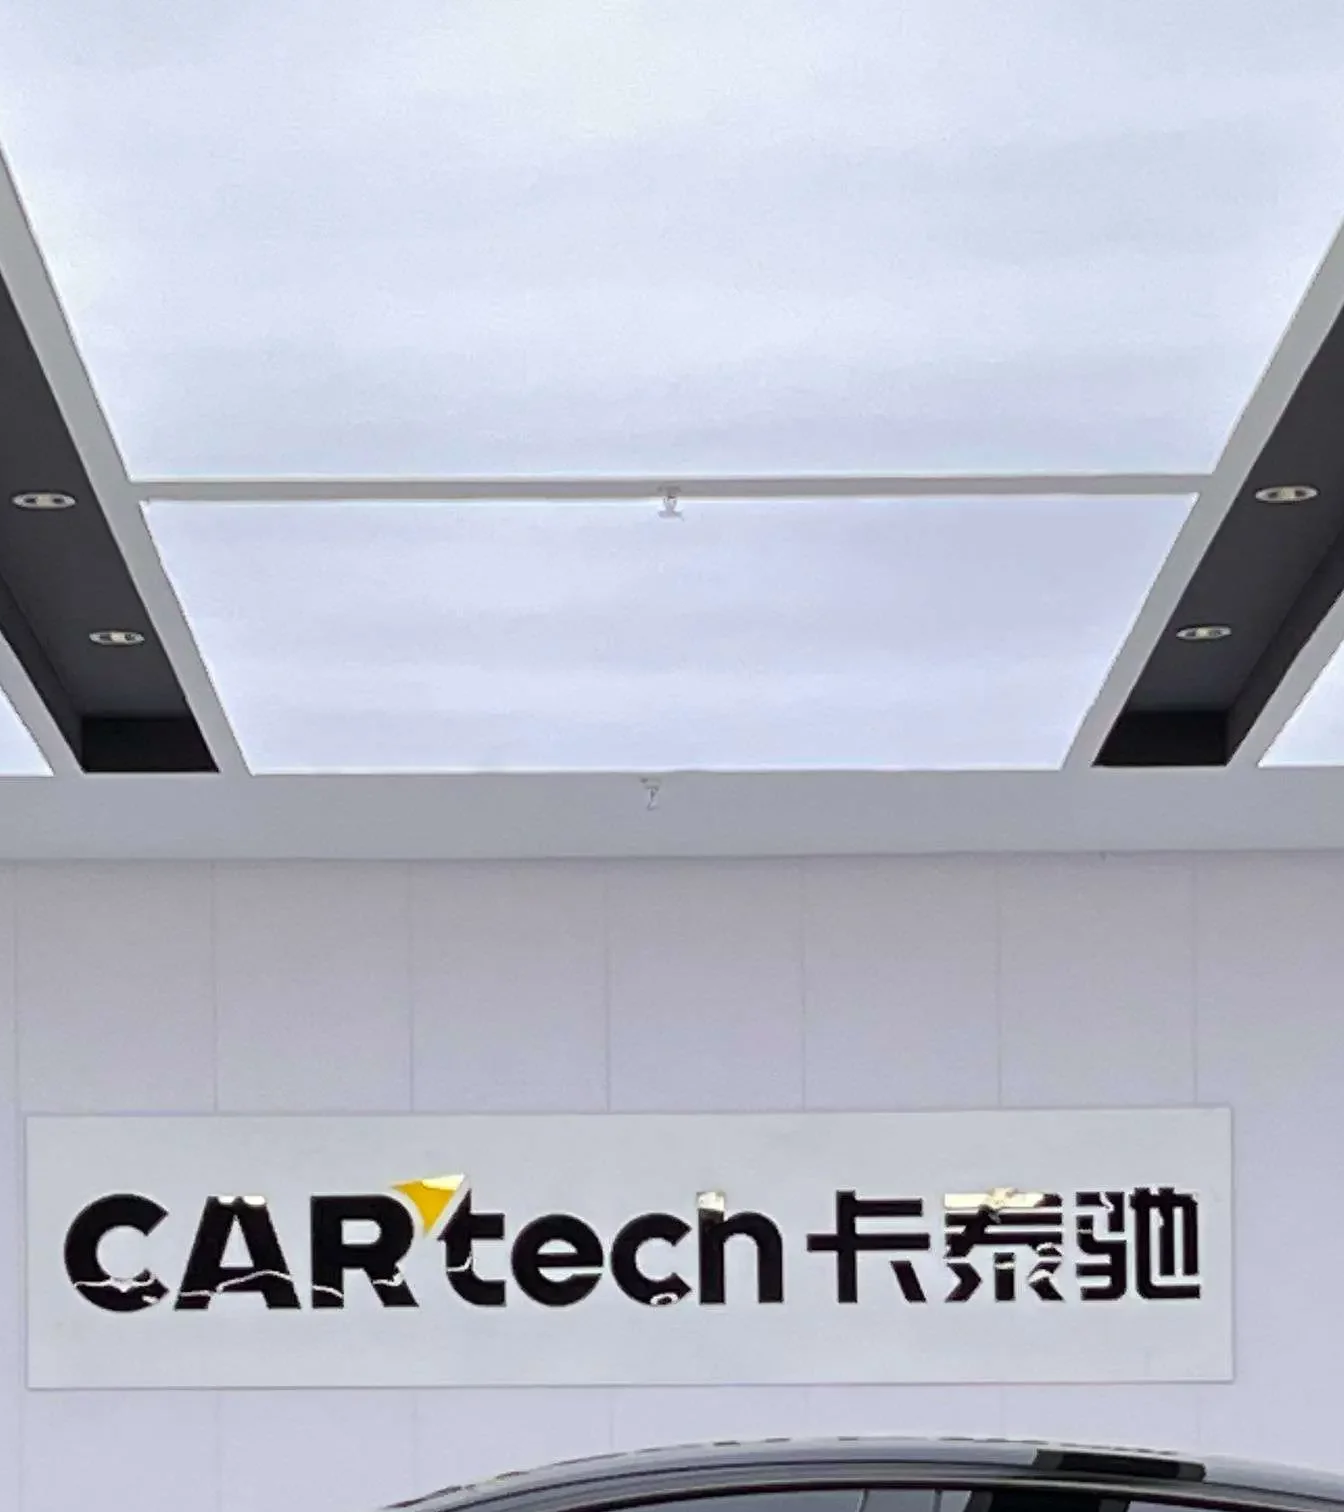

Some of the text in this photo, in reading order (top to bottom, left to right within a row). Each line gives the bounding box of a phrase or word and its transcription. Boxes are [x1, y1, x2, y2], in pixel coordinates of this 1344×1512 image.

[63, 1186, 1201, 1313] CARtech 卡泰驰
